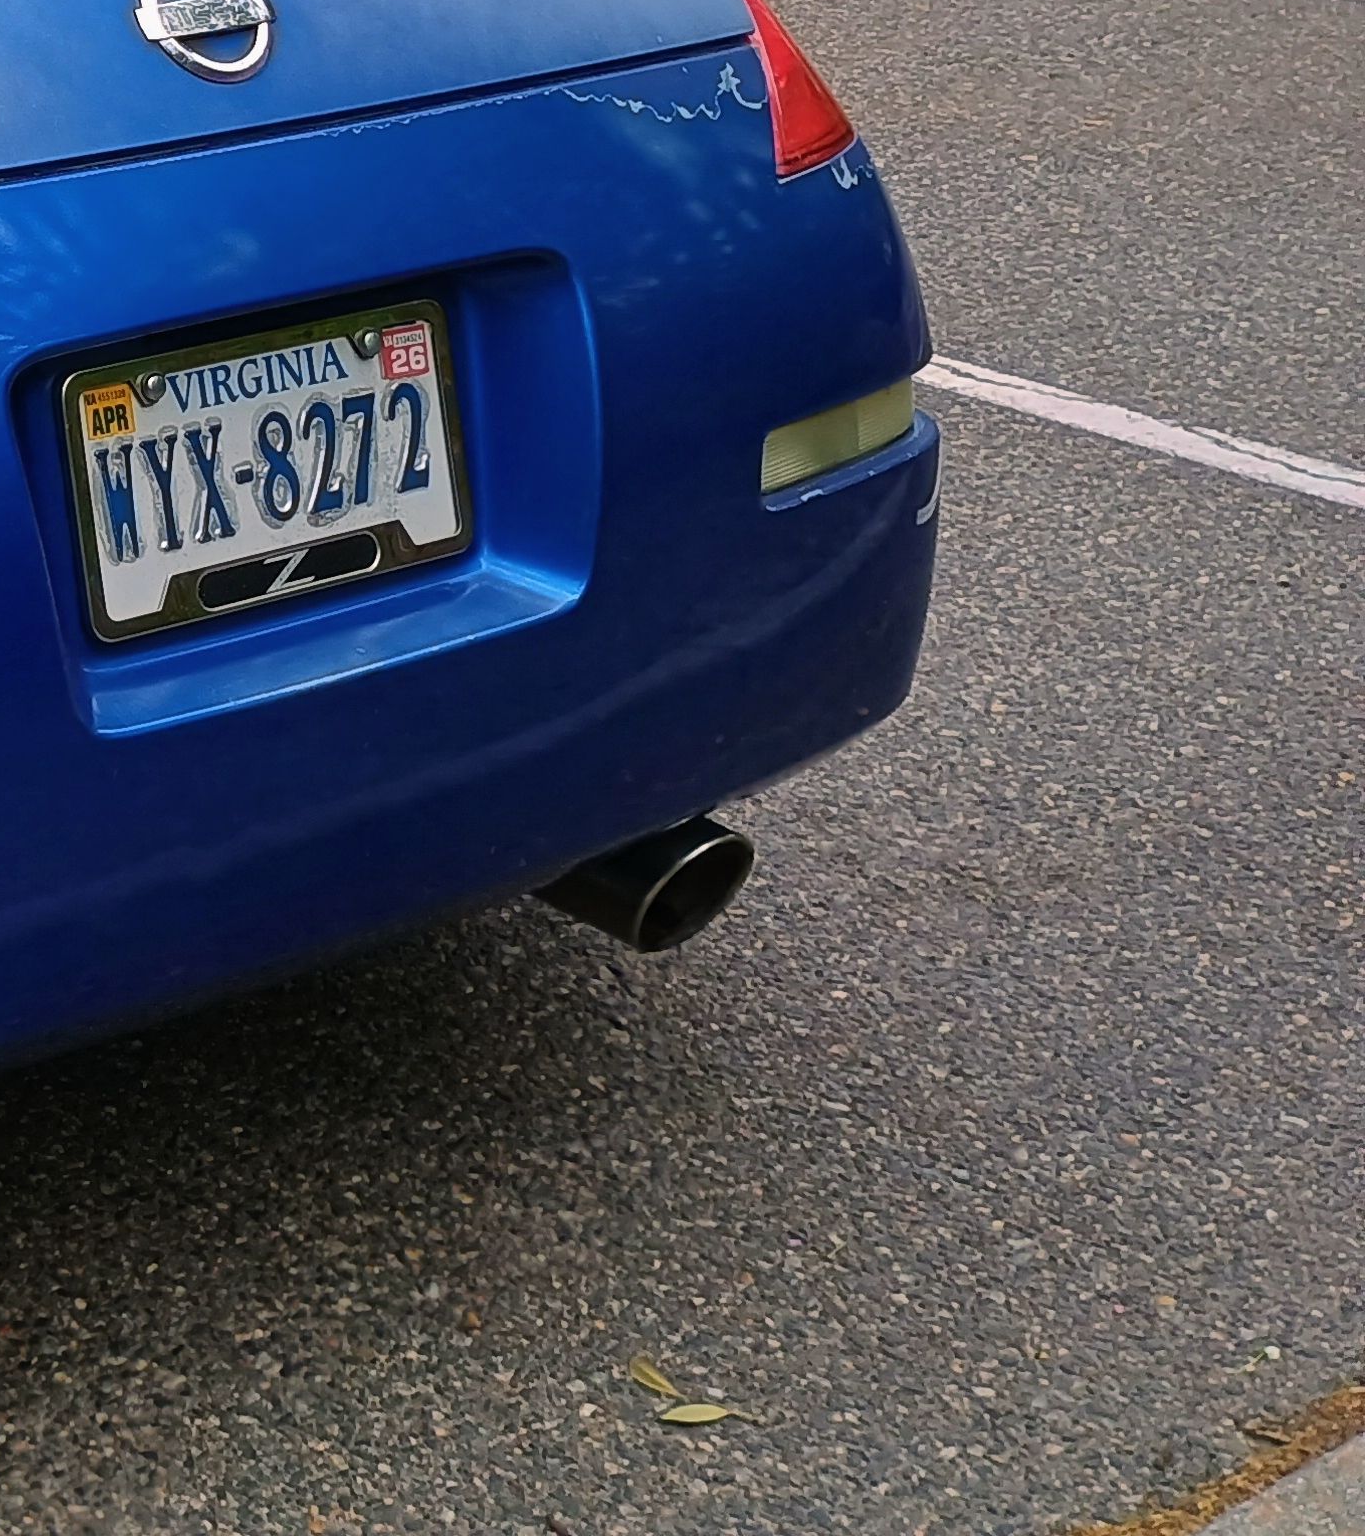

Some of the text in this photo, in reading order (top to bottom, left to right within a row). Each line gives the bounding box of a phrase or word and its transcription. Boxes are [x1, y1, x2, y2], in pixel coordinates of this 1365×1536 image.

[165, 342, 349, 413] VIRGINIA
[391, 345, 425, 374] 26
[93, 404, 130, 437] APR
[95, 382, 430, 562] WYX-8272
